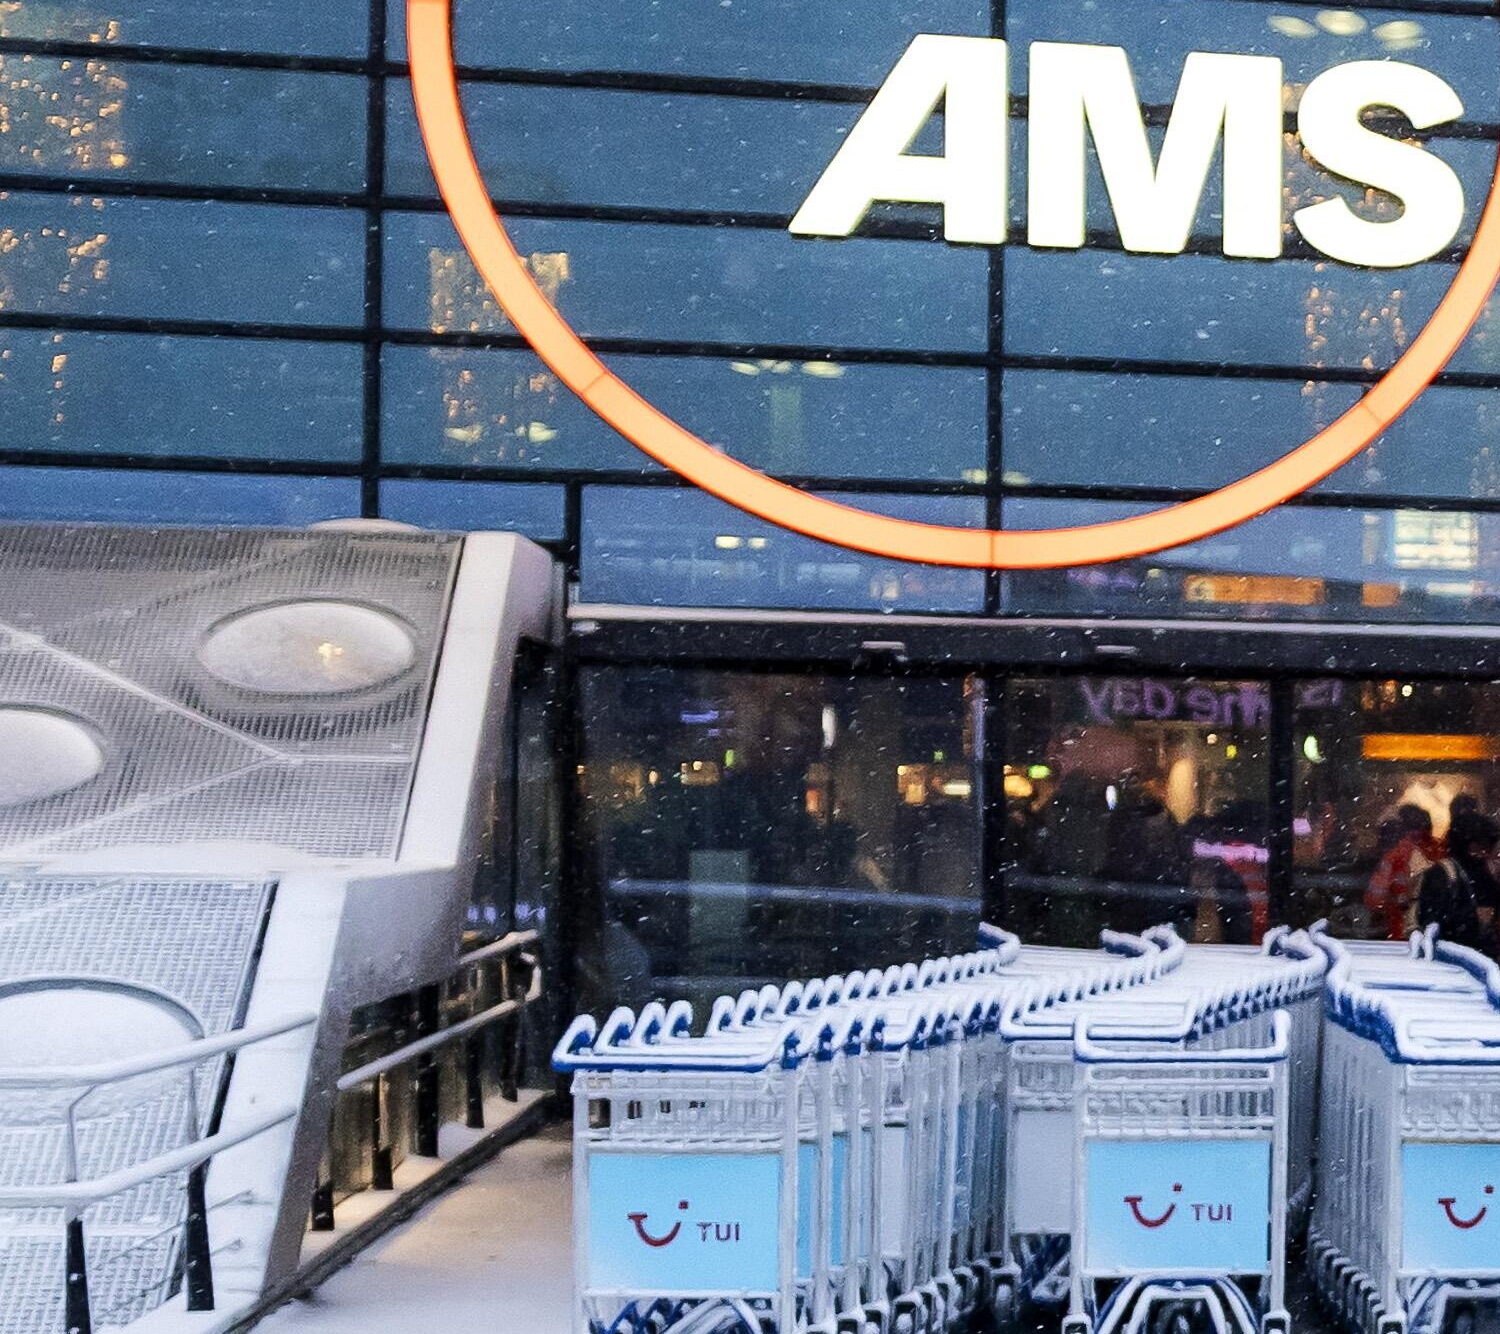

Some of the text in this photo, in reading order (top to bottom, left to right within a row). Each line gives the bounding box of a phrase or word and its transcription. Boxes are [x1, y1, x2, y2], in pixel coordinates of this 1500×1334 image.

[788, 33, 1465, 269] AMS
[1191, 1203, 1233, 1222] TUI
[696, 1221, 741, 1243] TUI
